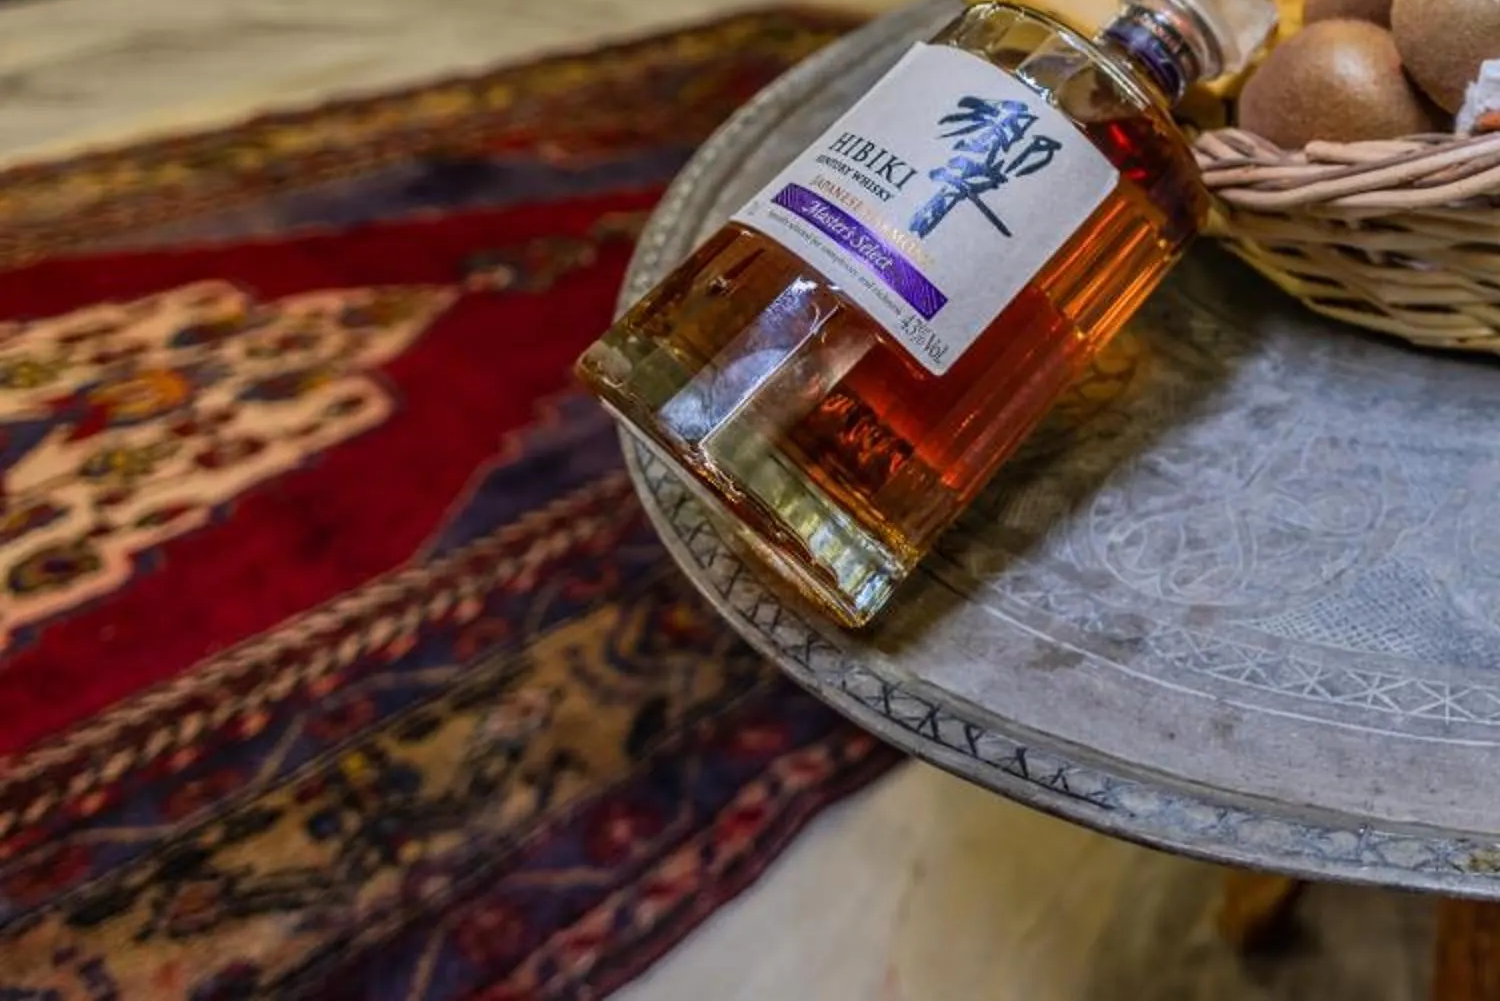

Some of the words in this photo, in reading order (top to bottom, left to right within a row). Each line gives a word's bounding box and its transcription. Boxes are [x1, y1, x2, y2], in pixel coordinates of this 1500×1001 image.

[828, 132, 918, 192] HIBIKI
[850, 169, 897, 202] WHISKY
[802, 199, 856, 246] Master's
[850, 233, 894, 270] Select
